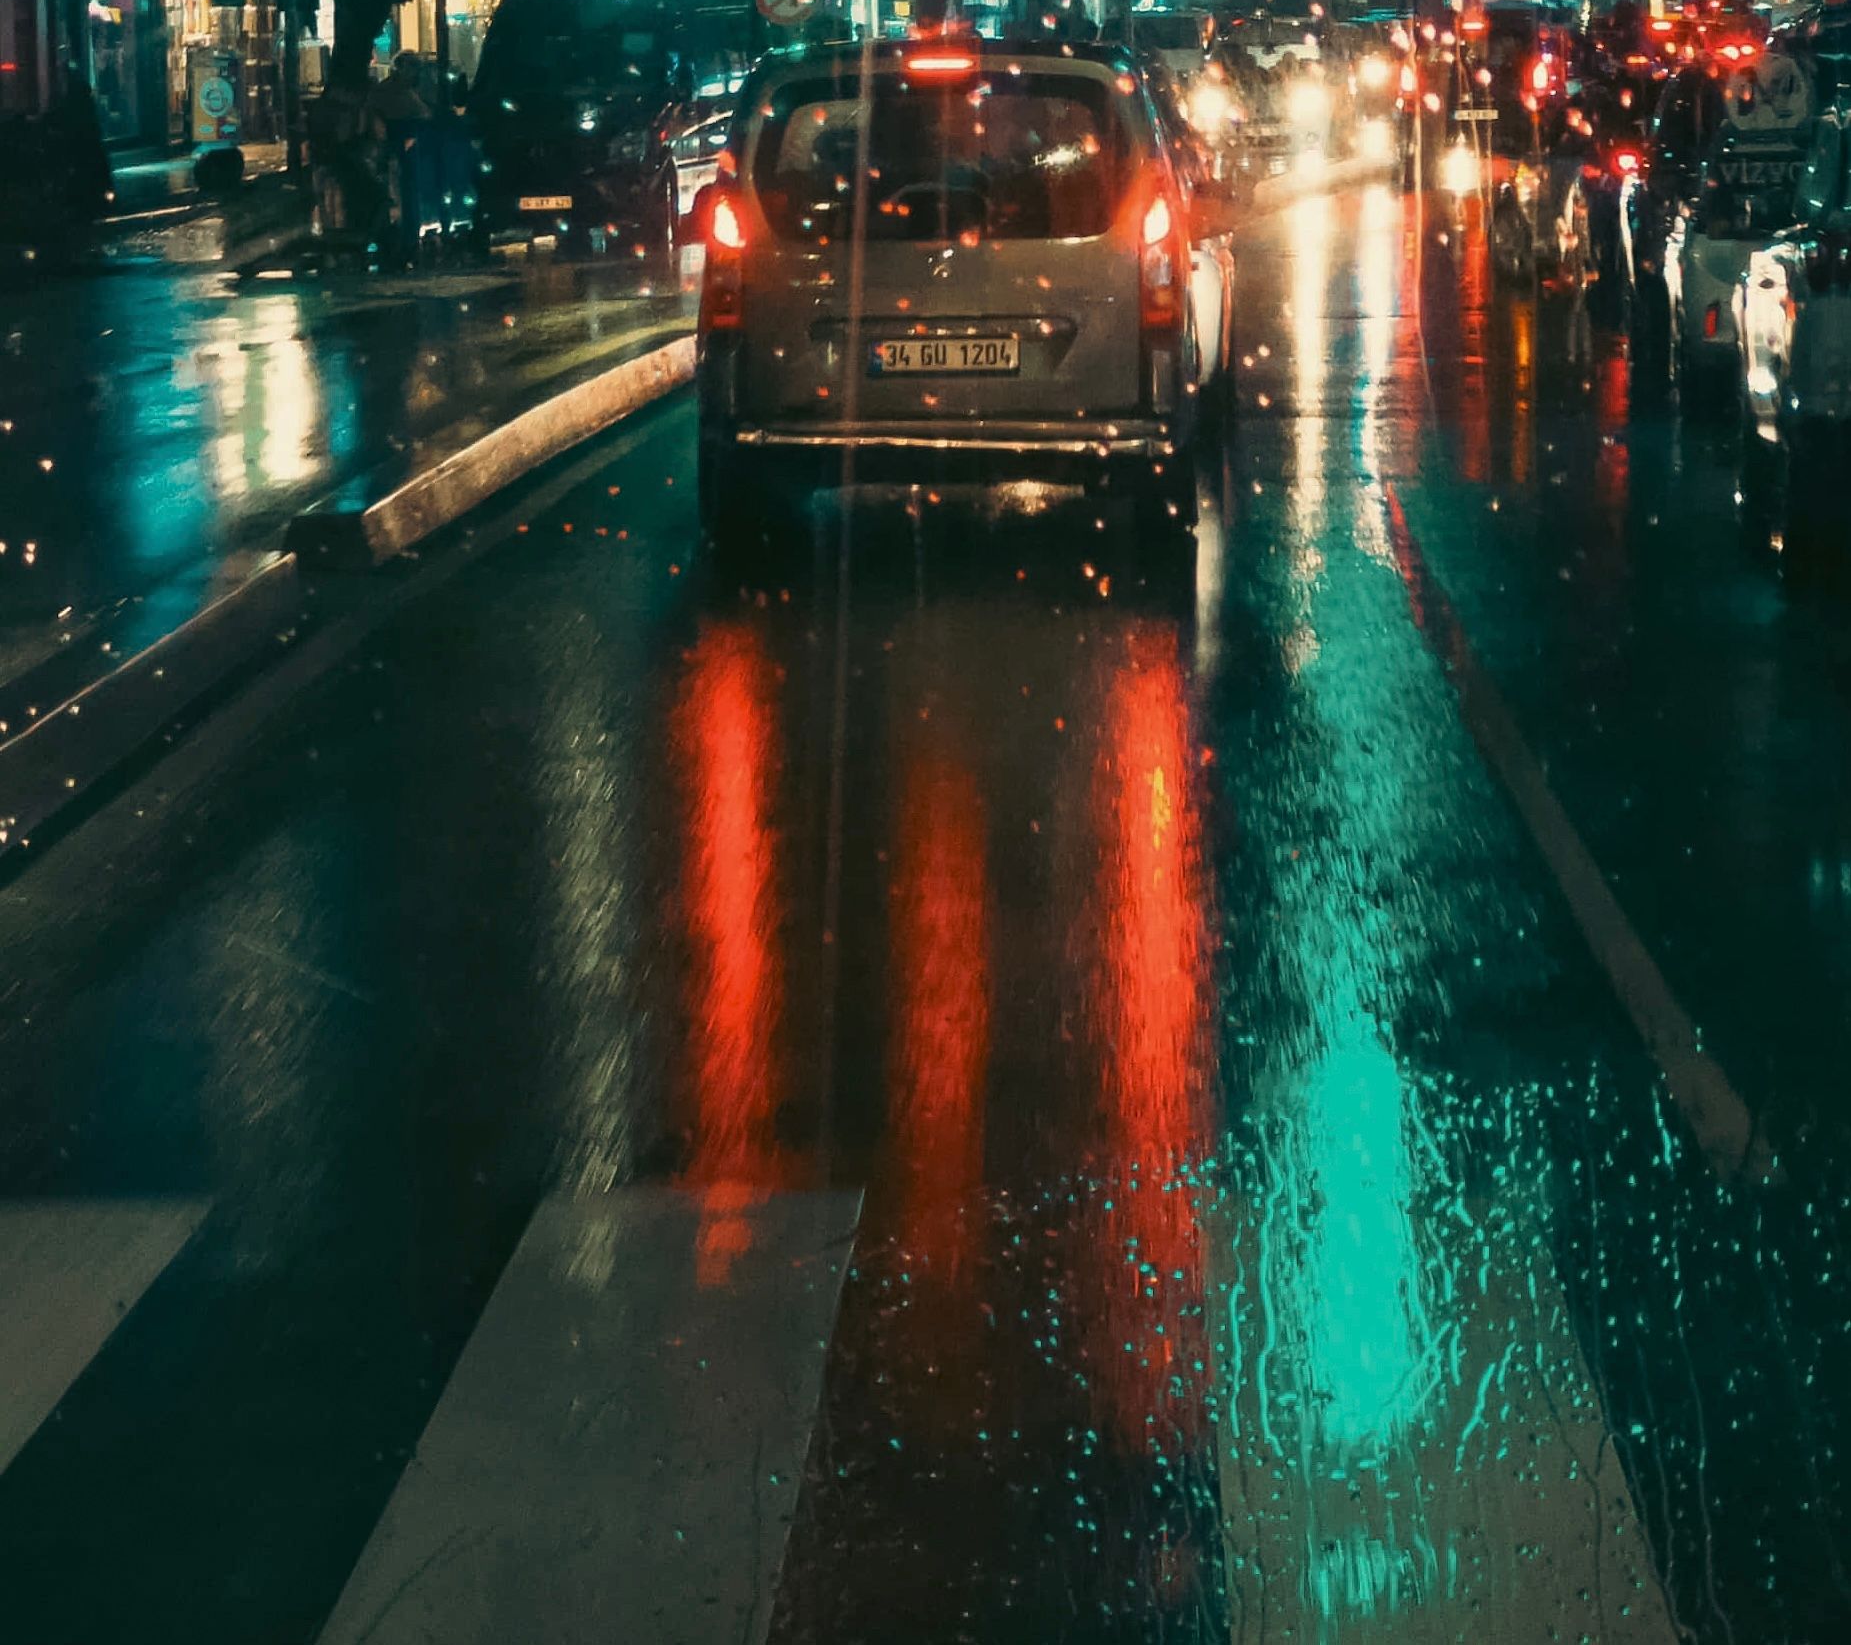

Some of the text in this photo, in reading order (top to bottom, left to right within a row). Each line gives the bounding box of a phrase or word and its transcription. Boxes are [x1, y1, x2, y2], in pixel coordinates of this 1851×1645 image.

[886, 342, 1012, 367] 34 GU 1204
